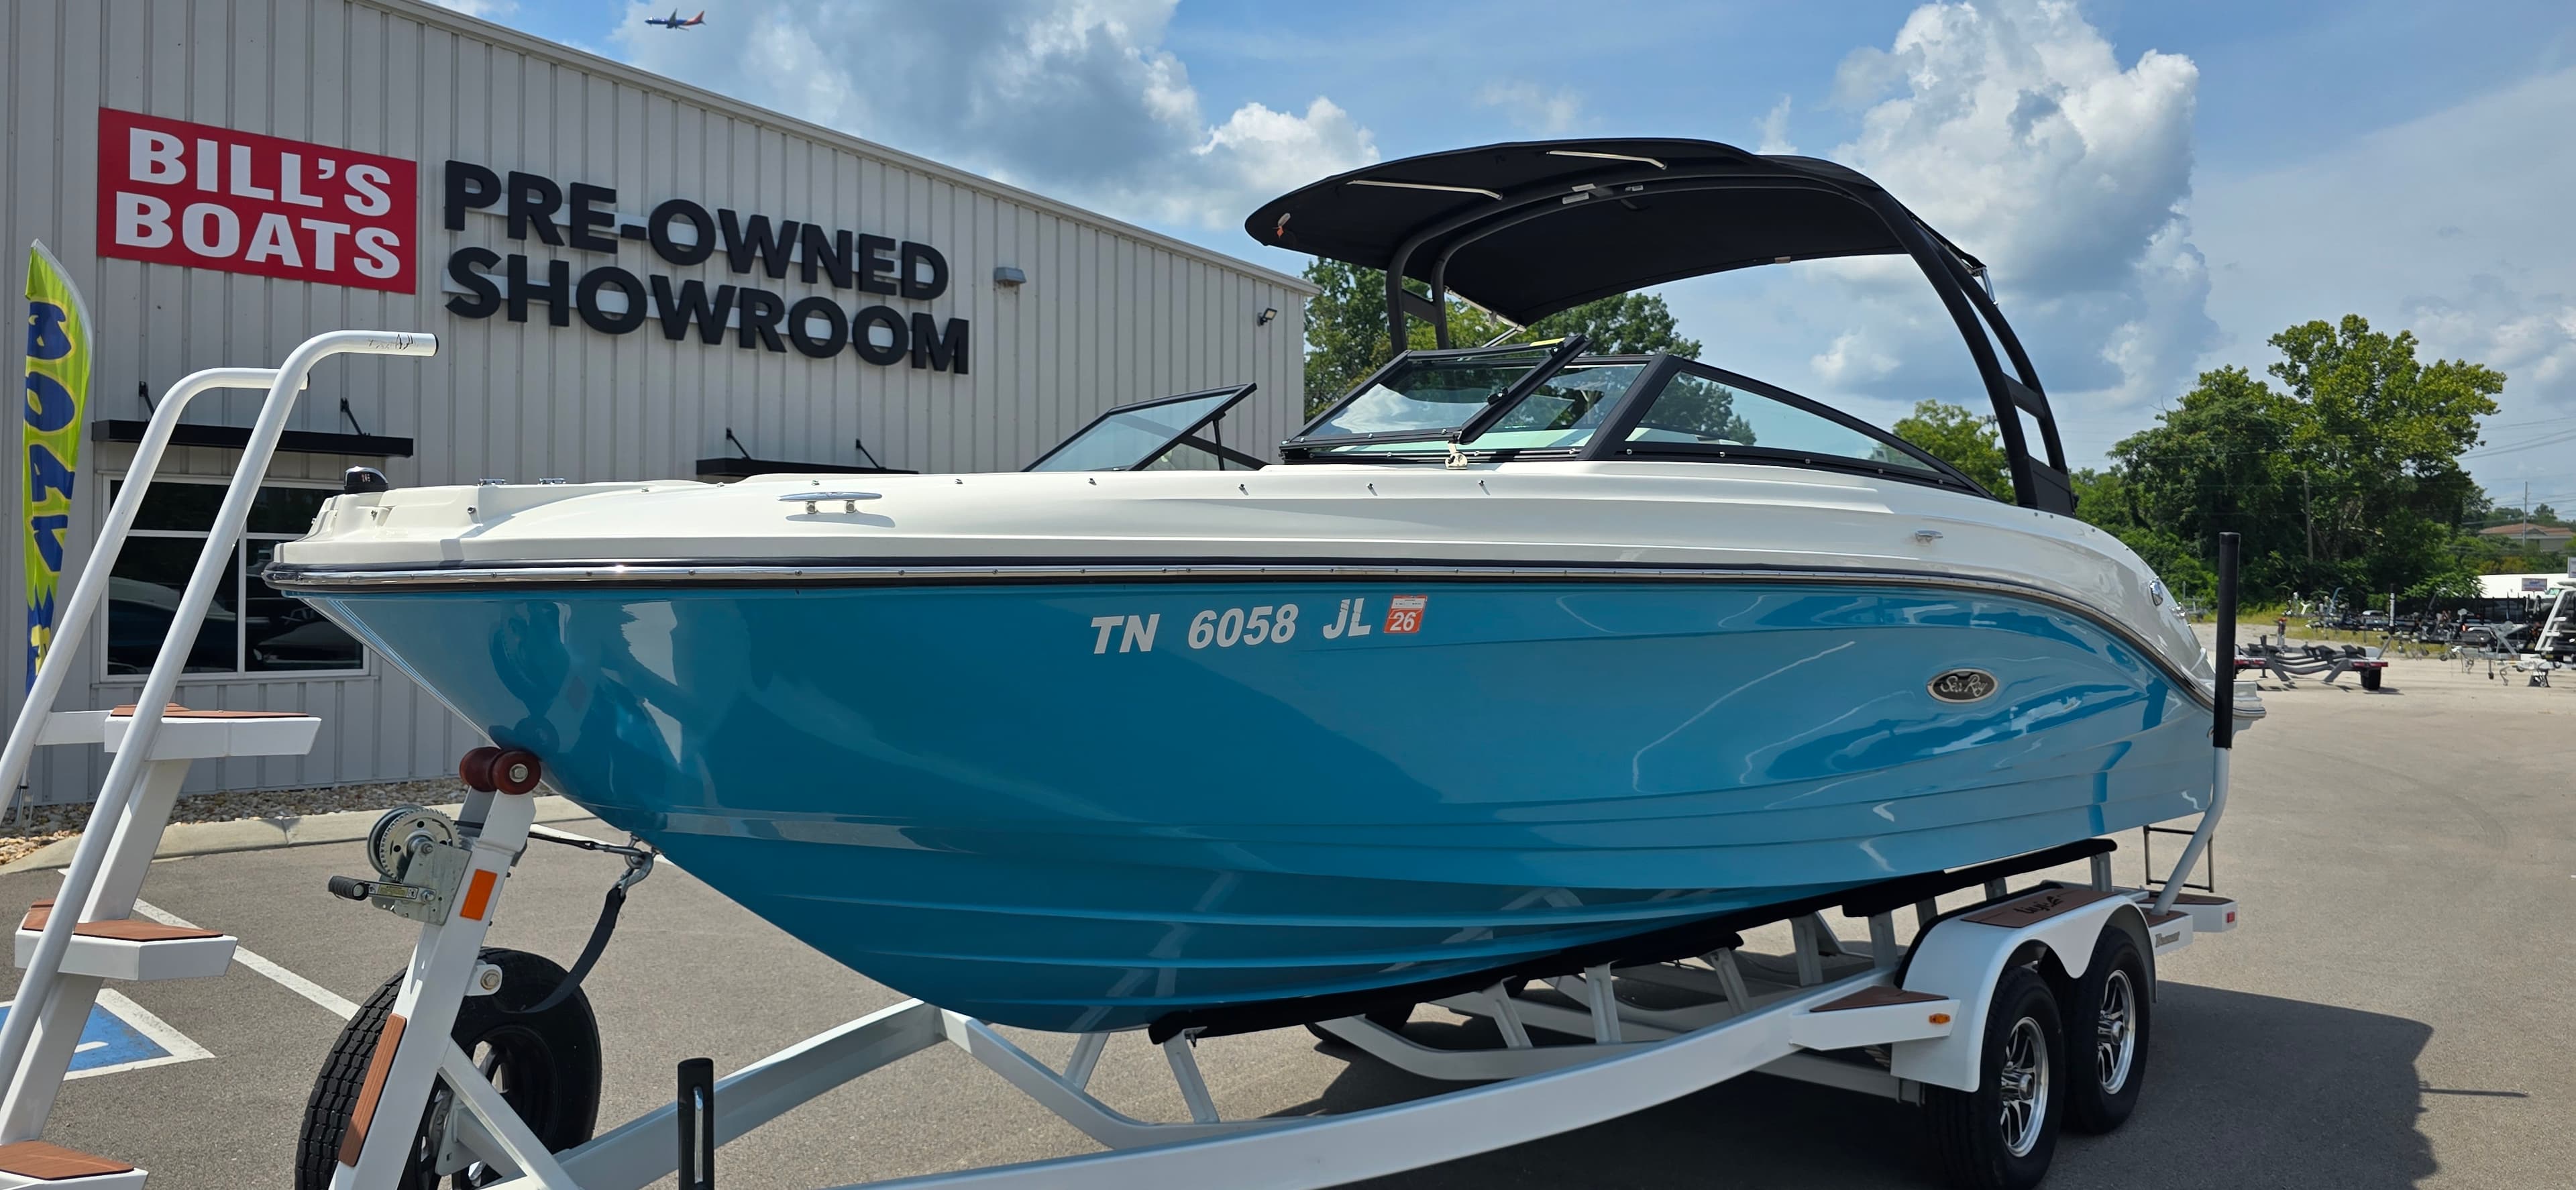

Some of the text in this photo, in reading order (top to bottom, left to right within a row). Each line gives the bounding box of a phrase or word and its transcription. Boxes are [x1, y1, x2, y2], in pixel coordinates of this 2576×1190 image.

[129, 127, 391, 216] BILL'S
[115, 191, 400, 278] BOATS
[445, 159, 949, 301] PRE-OWNED
[445, 246, 969, 374] SHOWROOM
[1091, 598, 1371, 654] TN 6058 JL
[1389, 611, 1417, 631] 26
